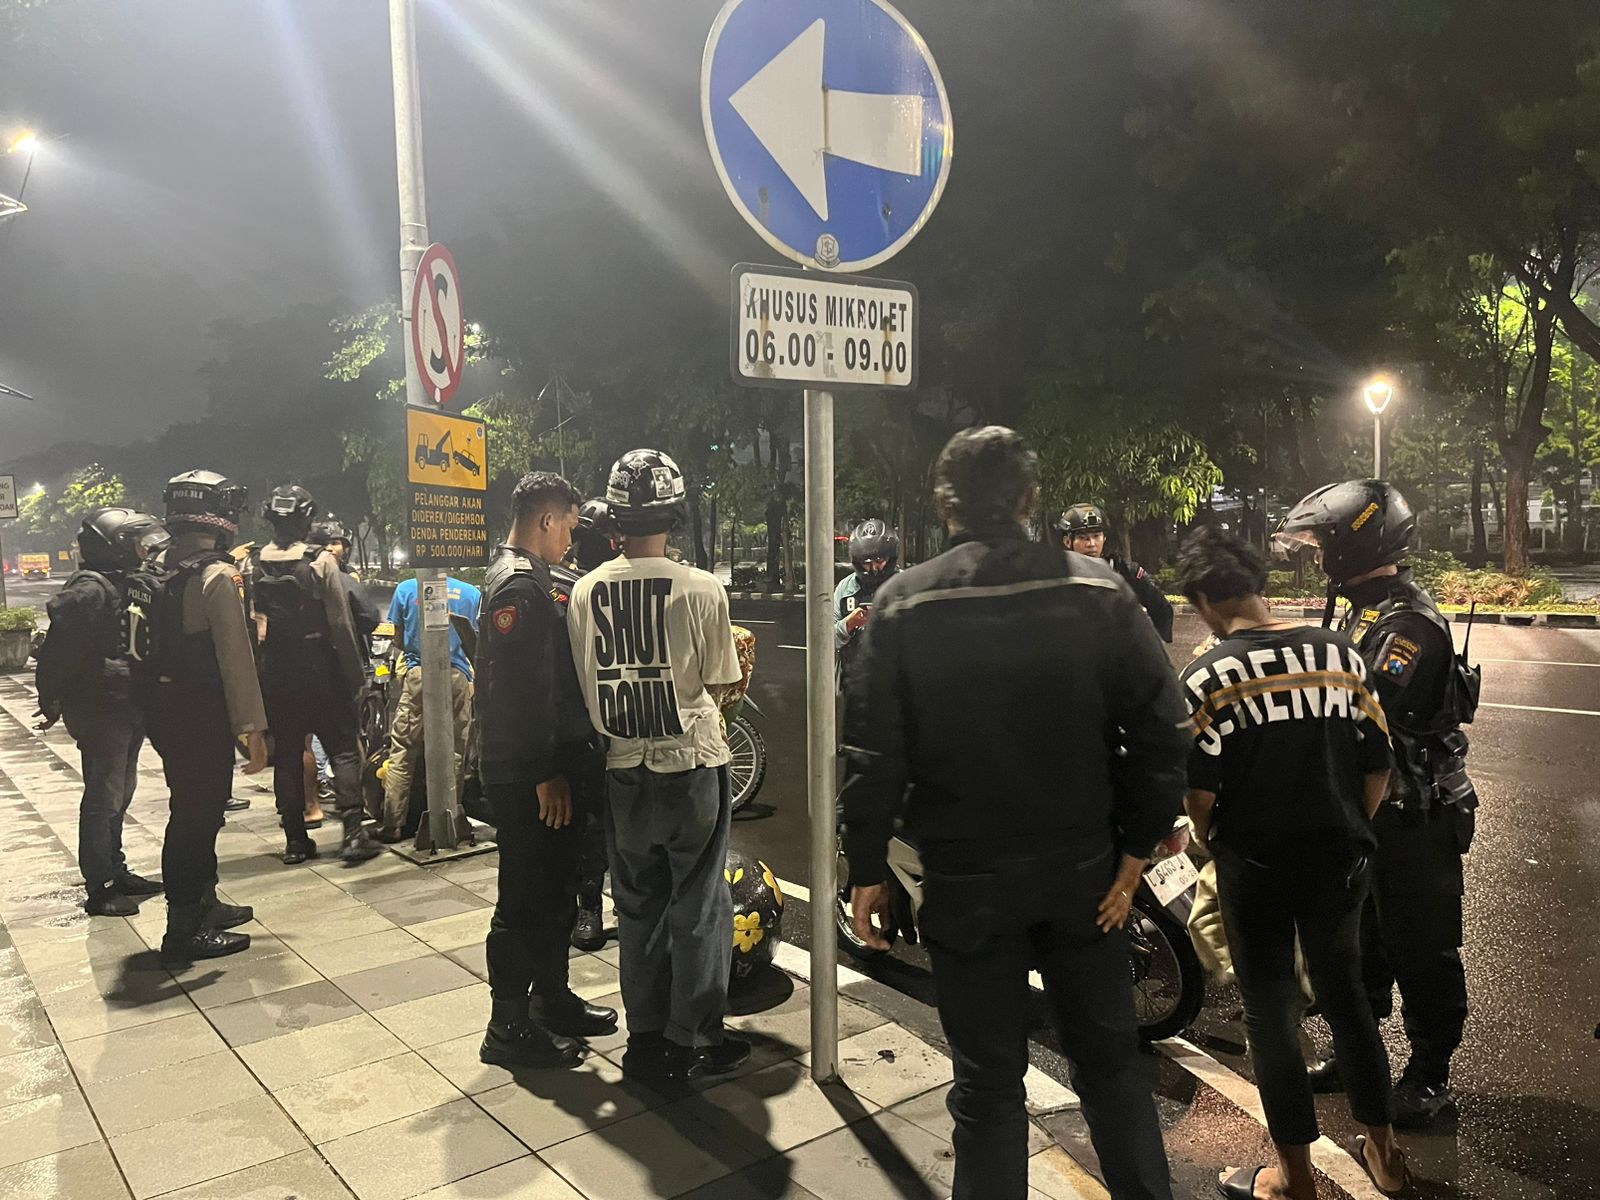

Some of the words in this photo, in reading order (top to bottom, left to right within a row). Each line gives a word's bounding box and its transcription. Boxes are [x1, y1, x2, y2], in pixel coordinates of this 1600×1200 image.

[746, 287, 817, 325] KHUSUS
[825, 295, 907, 333] MIKROLET
[745, 329, 816, 368] 06.00
[844, 337, 907, 373] 09.00
[415, 492, 459, 508] PELANGGAR
[462, 496, 482, 509] AKAN
[411, 509, 485, 525] DIDEREK/DIGEMBOK
[411, 526, 437, 540] DENDA
[440, 528, 487, 541] PENDEREKAN
[416, 544, 426, 557] RP
[431, 545, 483, 558] 500.000/HARI
[127, 587, 152, 604] POLISI
[591, 578, 673, 667] SHUT
[598, 680, 685, 739] DOWN
